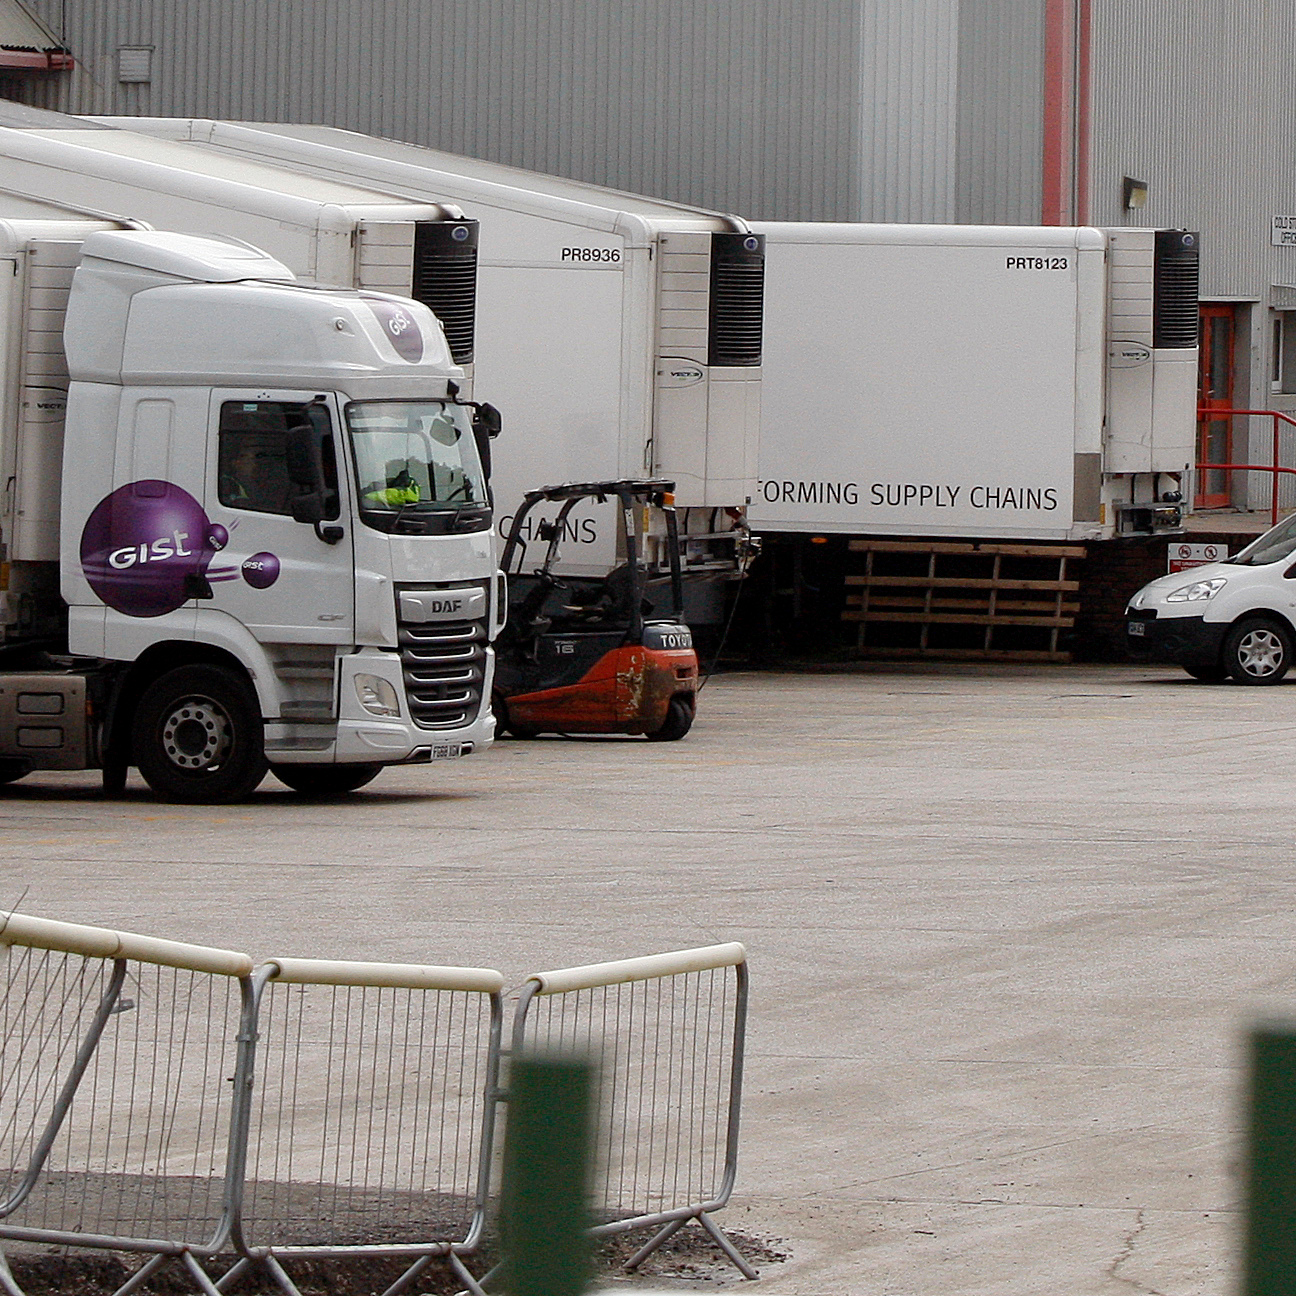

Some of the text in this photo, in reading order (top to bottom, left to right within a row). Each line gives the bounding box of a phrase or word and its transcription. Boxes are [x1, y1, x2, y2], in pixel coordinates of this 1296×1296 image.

[561, 247, 621, 262] PR8936
[1005, 257, 1068, 270] PRT8123
[870, 483, 961, 507] SUPPLY
[969, 485, 1058, 511] CHAINS
[498, 515, 597, 544] CHANS
[431, 599, 463, 615] DAF
[555, 644, 575, 654] 16
